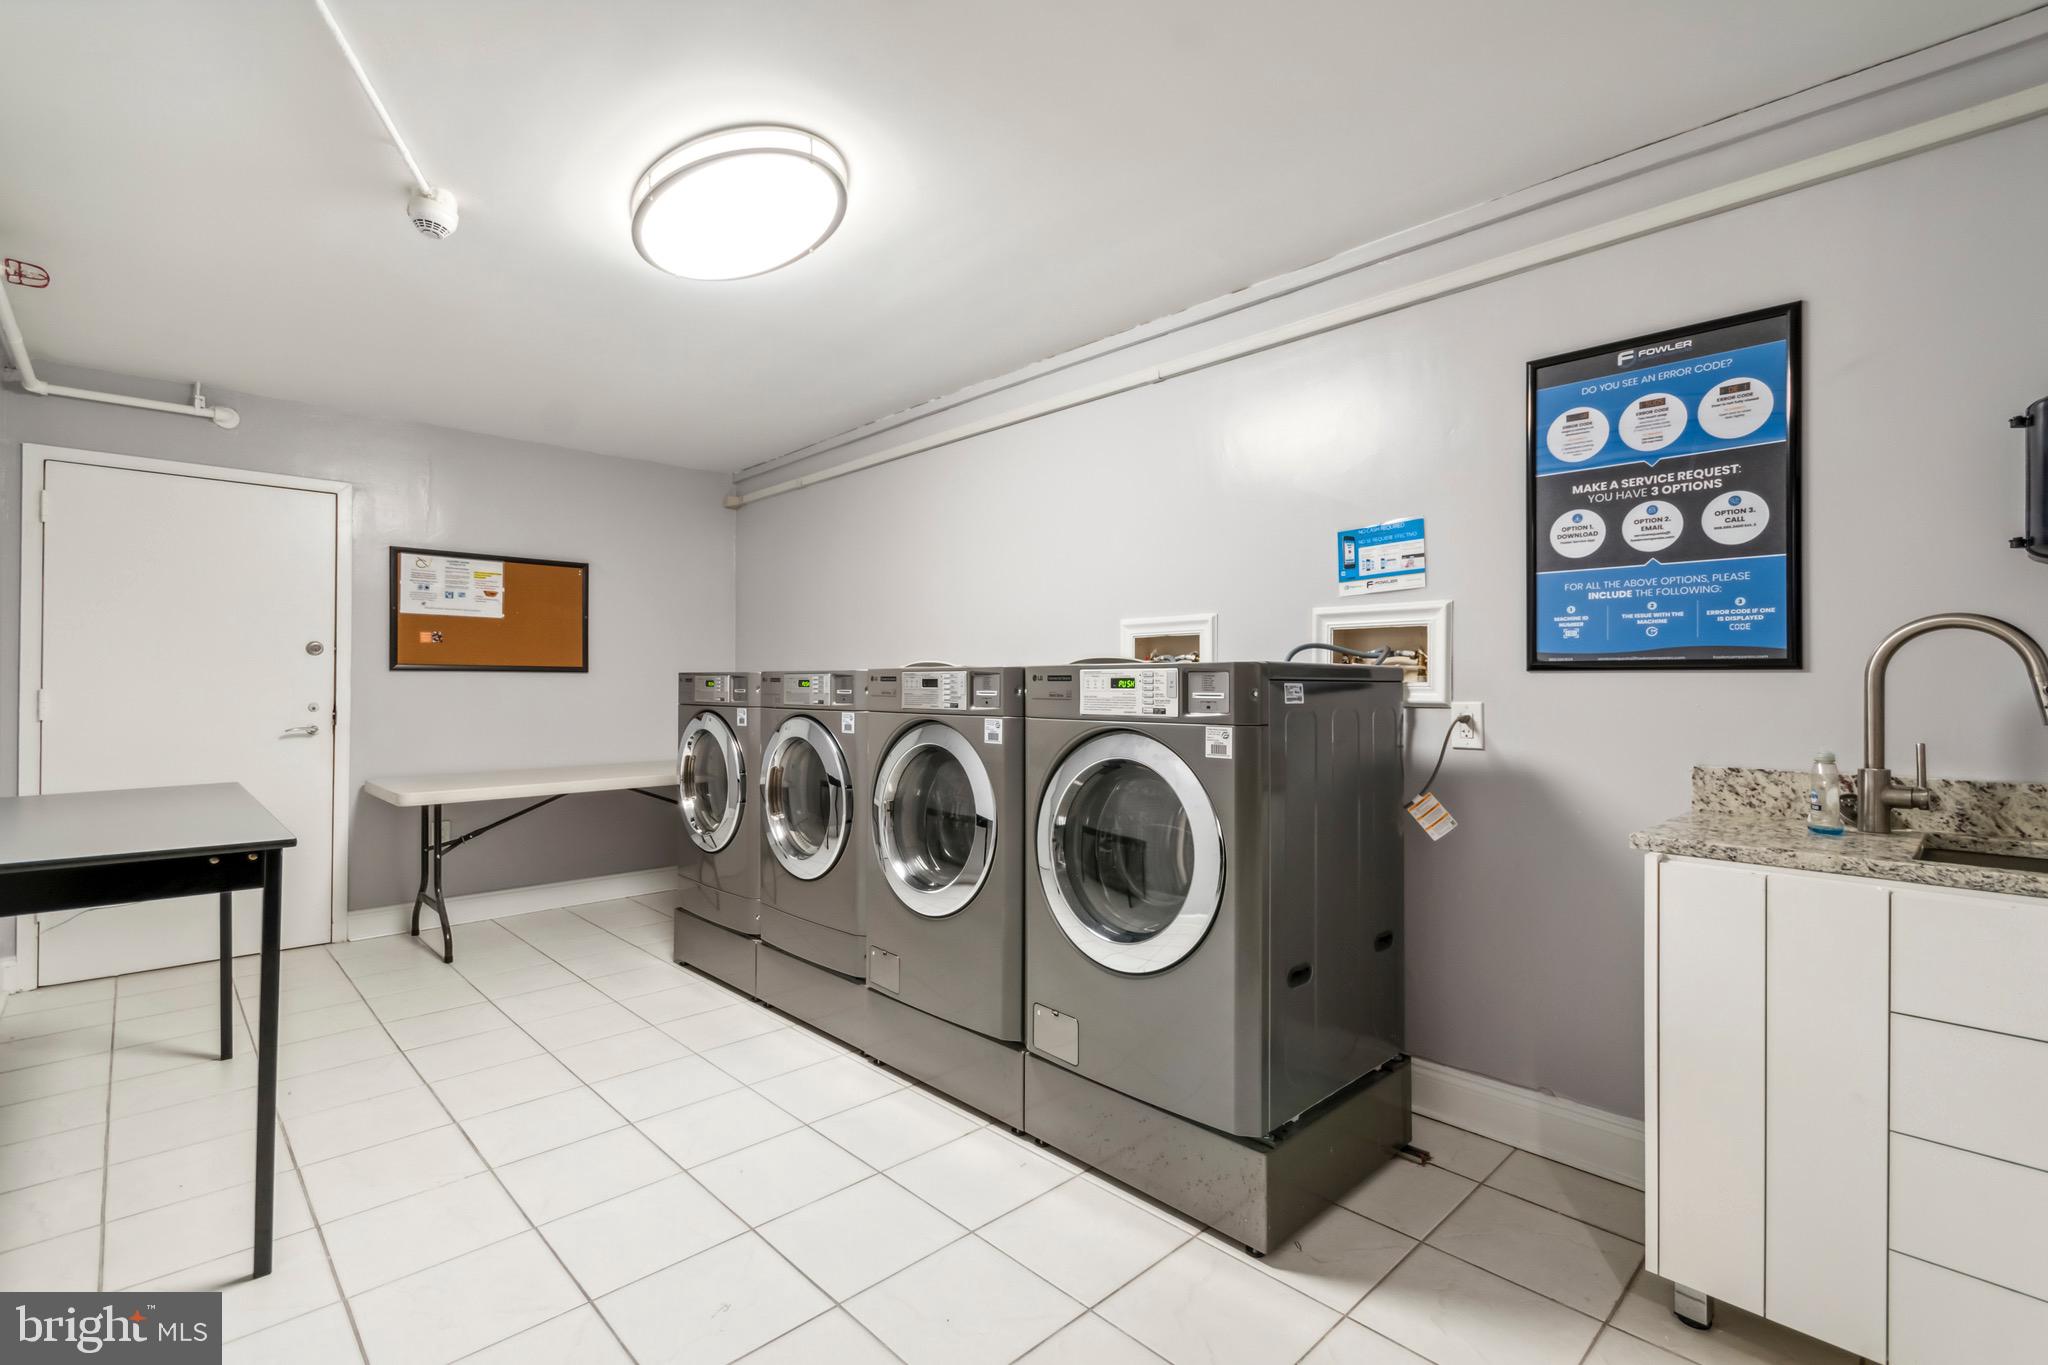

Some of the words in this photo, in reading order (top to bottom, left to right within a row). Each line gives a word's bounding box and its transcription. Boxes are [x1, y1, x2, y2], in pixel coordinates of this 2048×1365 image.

[1638, 340, 1692, 358] FOWLER
[1581, 386, 1598, 396] DO
[1600, 380, 1620, 392] YOU
[1622, 378, 1639, 388] SEE
[1641, 374, 1656, 384] AN
[1658, 368, 1692, 380] ERROR
[1694, 358, 1733, 373] CODE?
[1572, 480, 1608, 494] MAKE
[1609, 479, 1619, 489] A
[1621, 470, 1674, 488] SERVICE
[1677, 464, 1742, 482] REQUEST:
[1588, 492, 1612, 503] YOU
[1616, 488, 1647, 500] HAVE
[1650, 486, 1658, 496] 3
[1662, 478, 1722, 495] OPTIONS
[1634, 517, 1663, 525] OPTION
[1714, 508, 1747, 516] OPTION
[1557, 531, 1598, 540] DOWNLOAD
[1564, 582, 1584, 591] FOR
[1586, 581, 1601, 590] ALL
[1604, 580, 1621, 588] THE
[1624, 577, 1658, 587] ABOVE
[1660, 574, 1708, 586] OPTIONS,
[1712, 572, 1751, 582] PLEASE
[1588, 590, 1632, 600] INCLUDE
[1635, 588, 1652, 597] THE
[1656, 585, 1722, 596] FOLLOWING:
